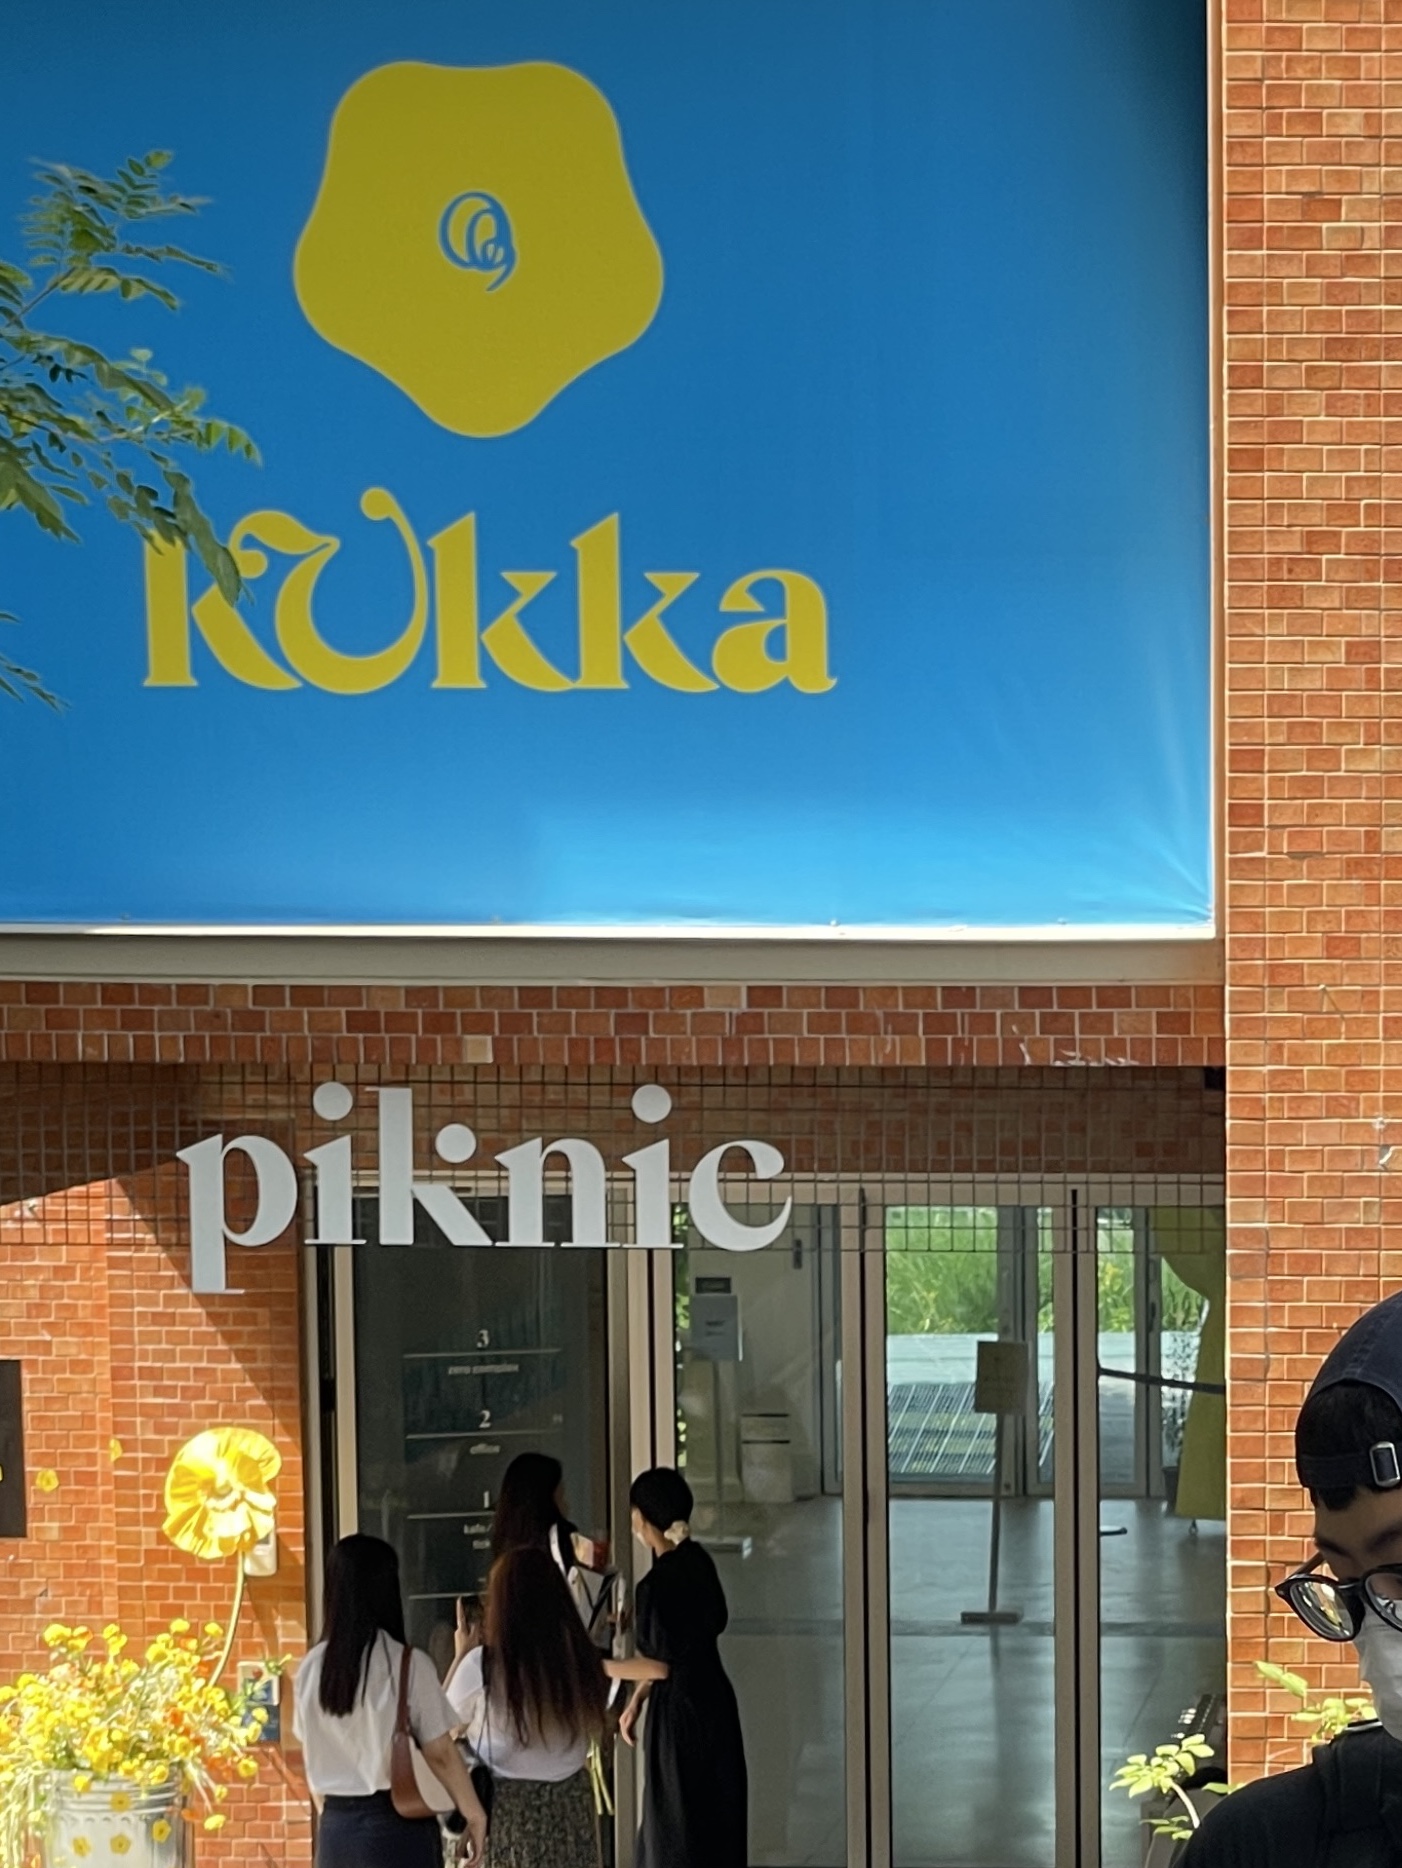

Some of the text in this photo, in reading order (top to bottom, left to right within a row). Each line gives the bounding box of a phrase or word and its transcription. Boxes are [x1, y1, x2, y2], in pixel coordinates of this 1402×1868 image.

[143, 487, 837, 694] kukka
[176, 1081, 792, 1295] piknic
[476, 1328, 490, 1348] 3
[479, 1410, 491, 1428] 2
